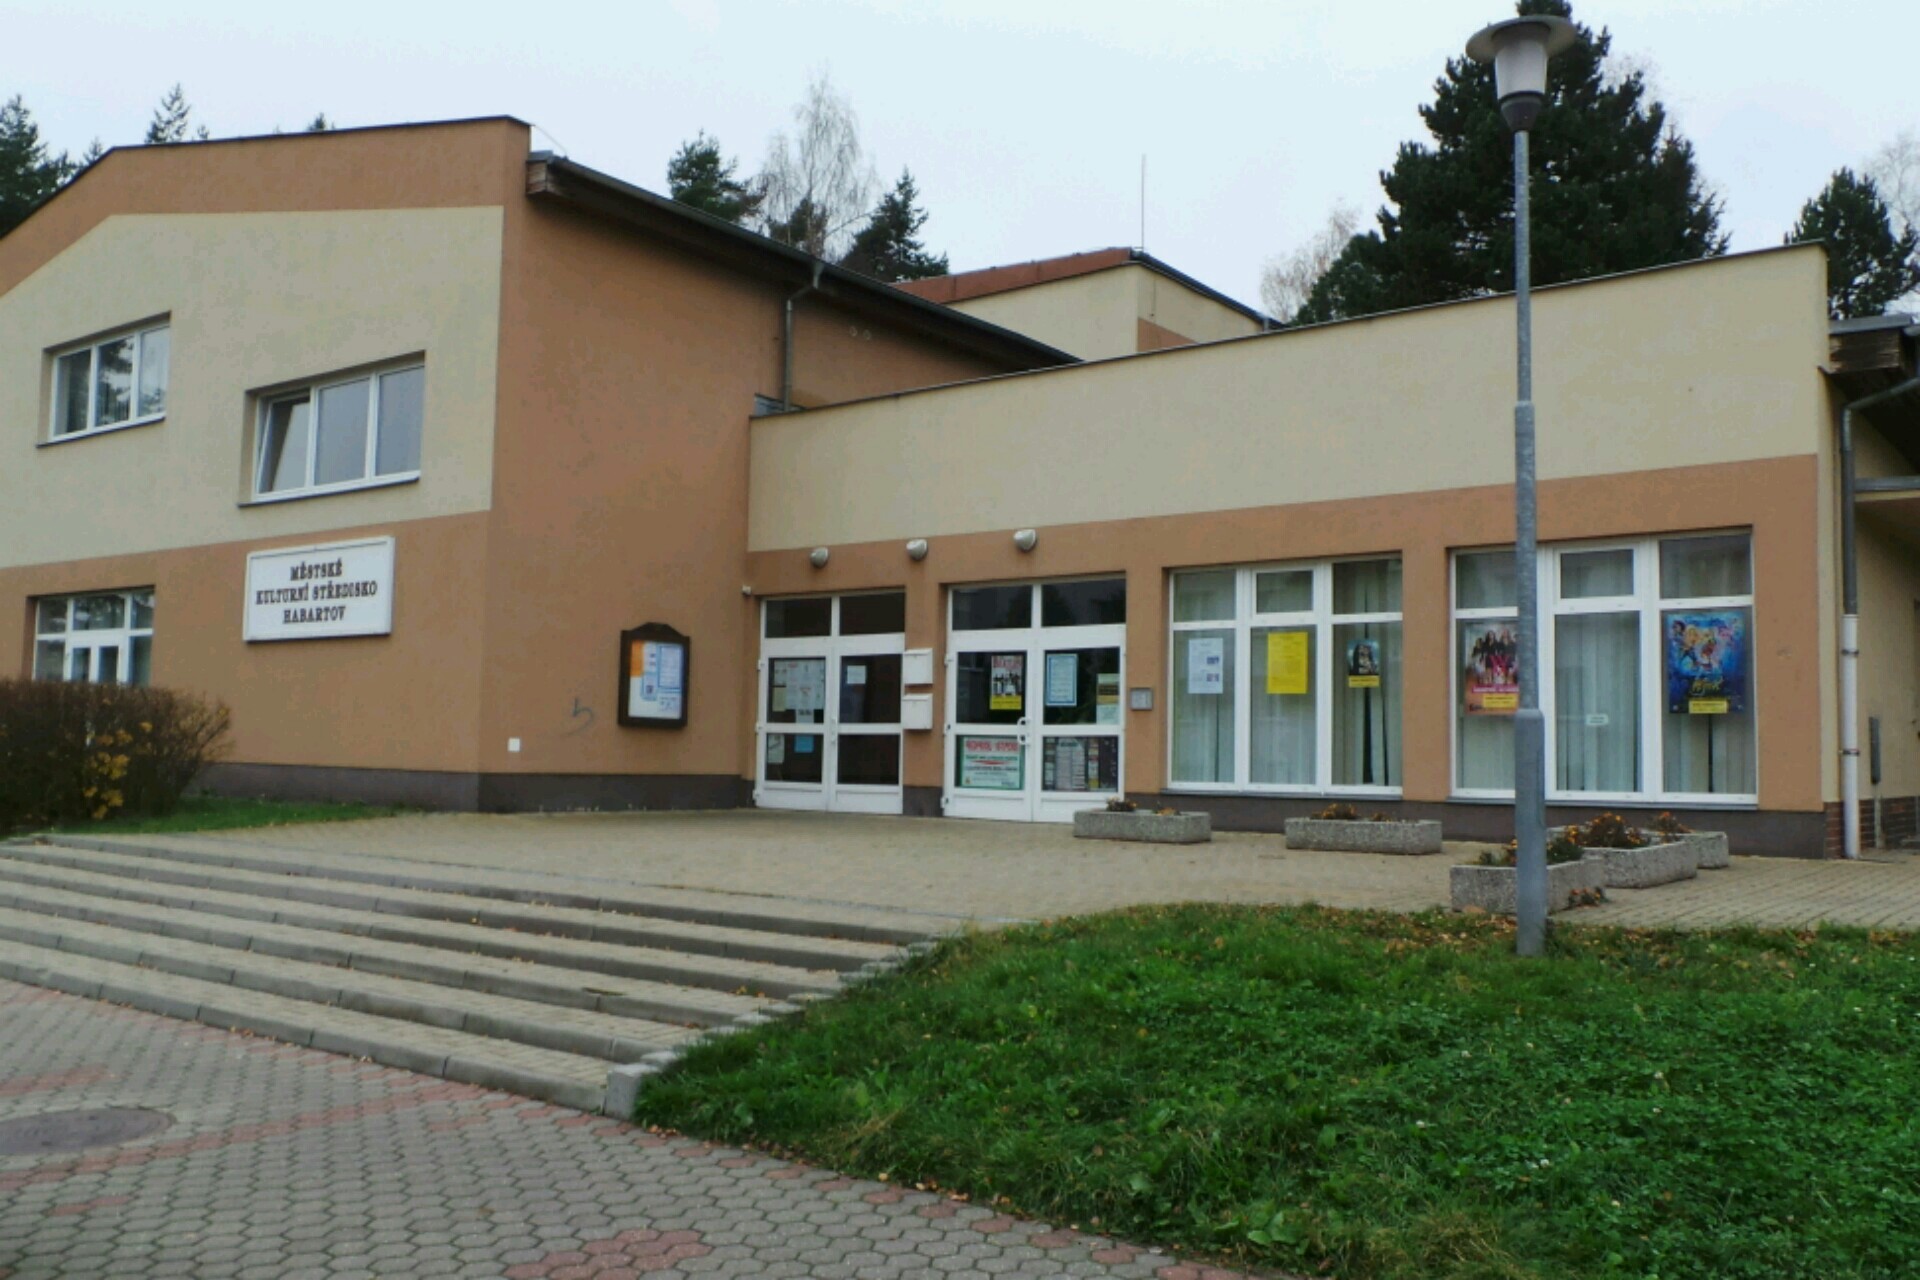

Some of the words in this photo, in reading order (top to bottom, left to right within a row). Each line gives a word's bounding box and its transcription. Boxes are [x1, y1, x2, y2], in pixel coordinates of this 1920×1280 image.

[290, 558, 342, 581] MĚSTSKÉ
[256, 582, 309, 605] KULTURNÍ
[283, 605, 346, 624] HABARTOV
